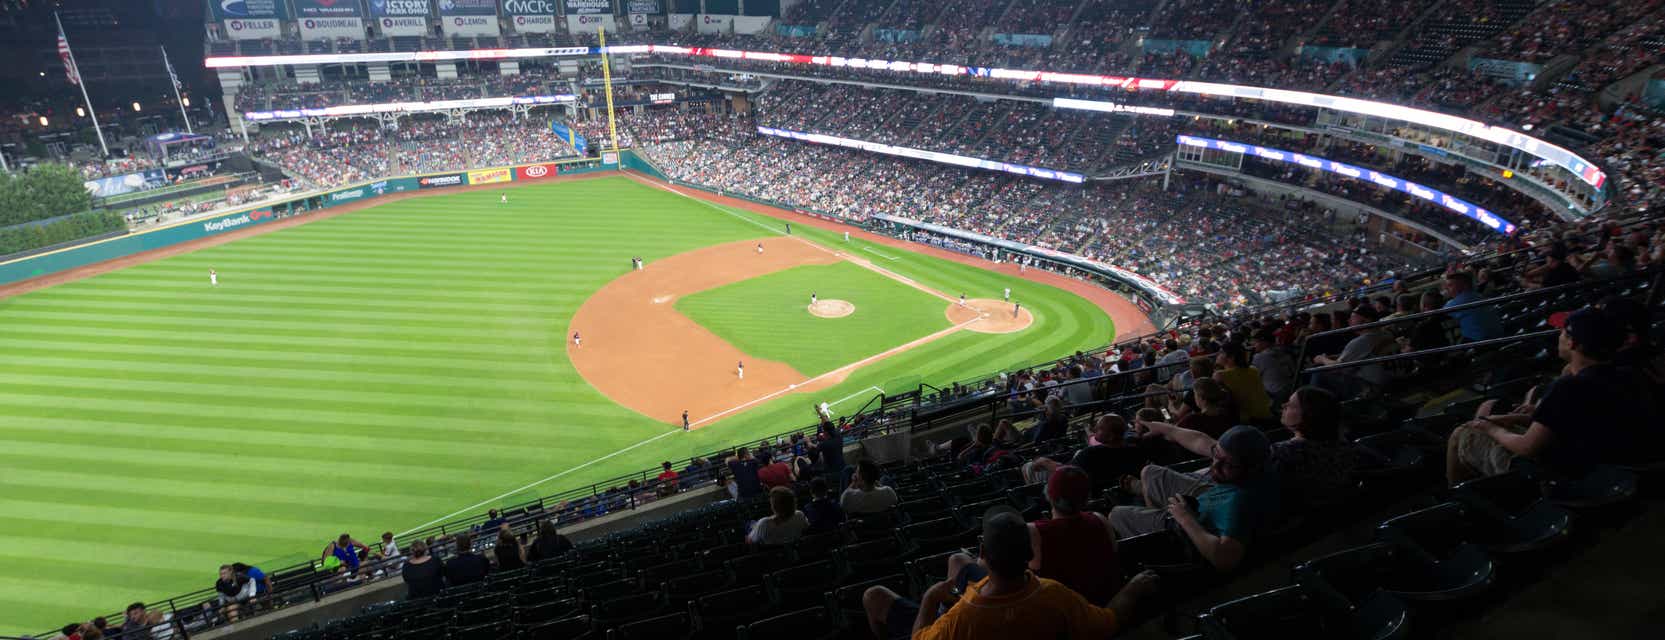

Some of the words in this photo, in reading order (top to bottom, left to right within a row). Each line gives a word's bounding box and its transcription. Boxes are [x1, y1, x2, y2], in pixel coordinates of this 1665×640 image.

[513, 1, 554, 14] MCPc
[244, 20, 273, 29] FELLER
[394, 18, 424, 27] AVERILL
[464, 17, 487, 26] LEMON
[526, 16, 551, 25] HARDER
[204, 214, 250, 232] KeyBank
